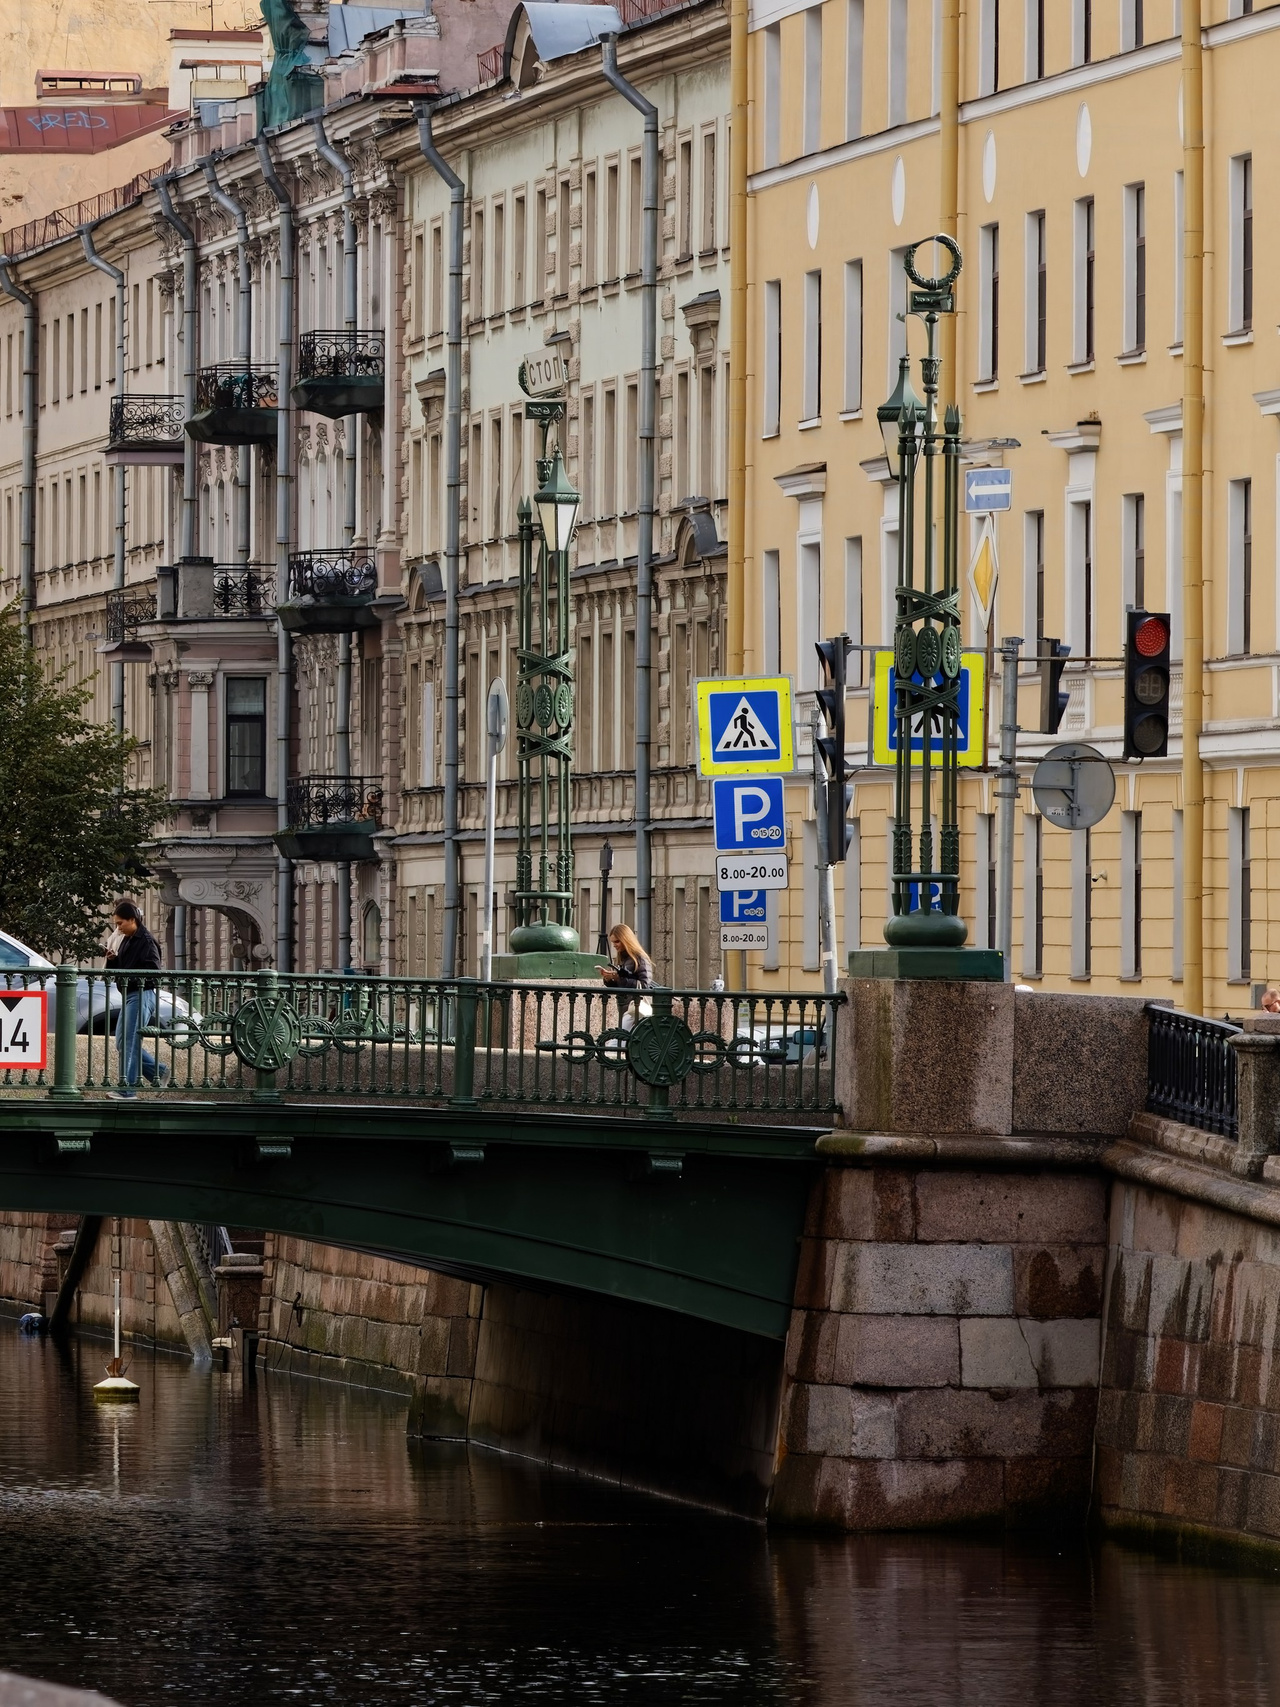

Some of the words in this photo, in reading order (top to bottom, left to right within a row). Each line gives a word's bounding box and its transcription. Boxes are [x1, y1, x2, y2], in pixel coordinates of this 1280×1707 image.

[529, 356, 561, 387] СТОП
[733, 786, 771, 842] P
[760, 829, 768, 837] 15
[769, 828, 781, 837] 20
[720, 866, 785, 880] 8.00-20.00
[733, 890, 759, 918] P
[722, 933, 766, 943] 8.00-20.00
